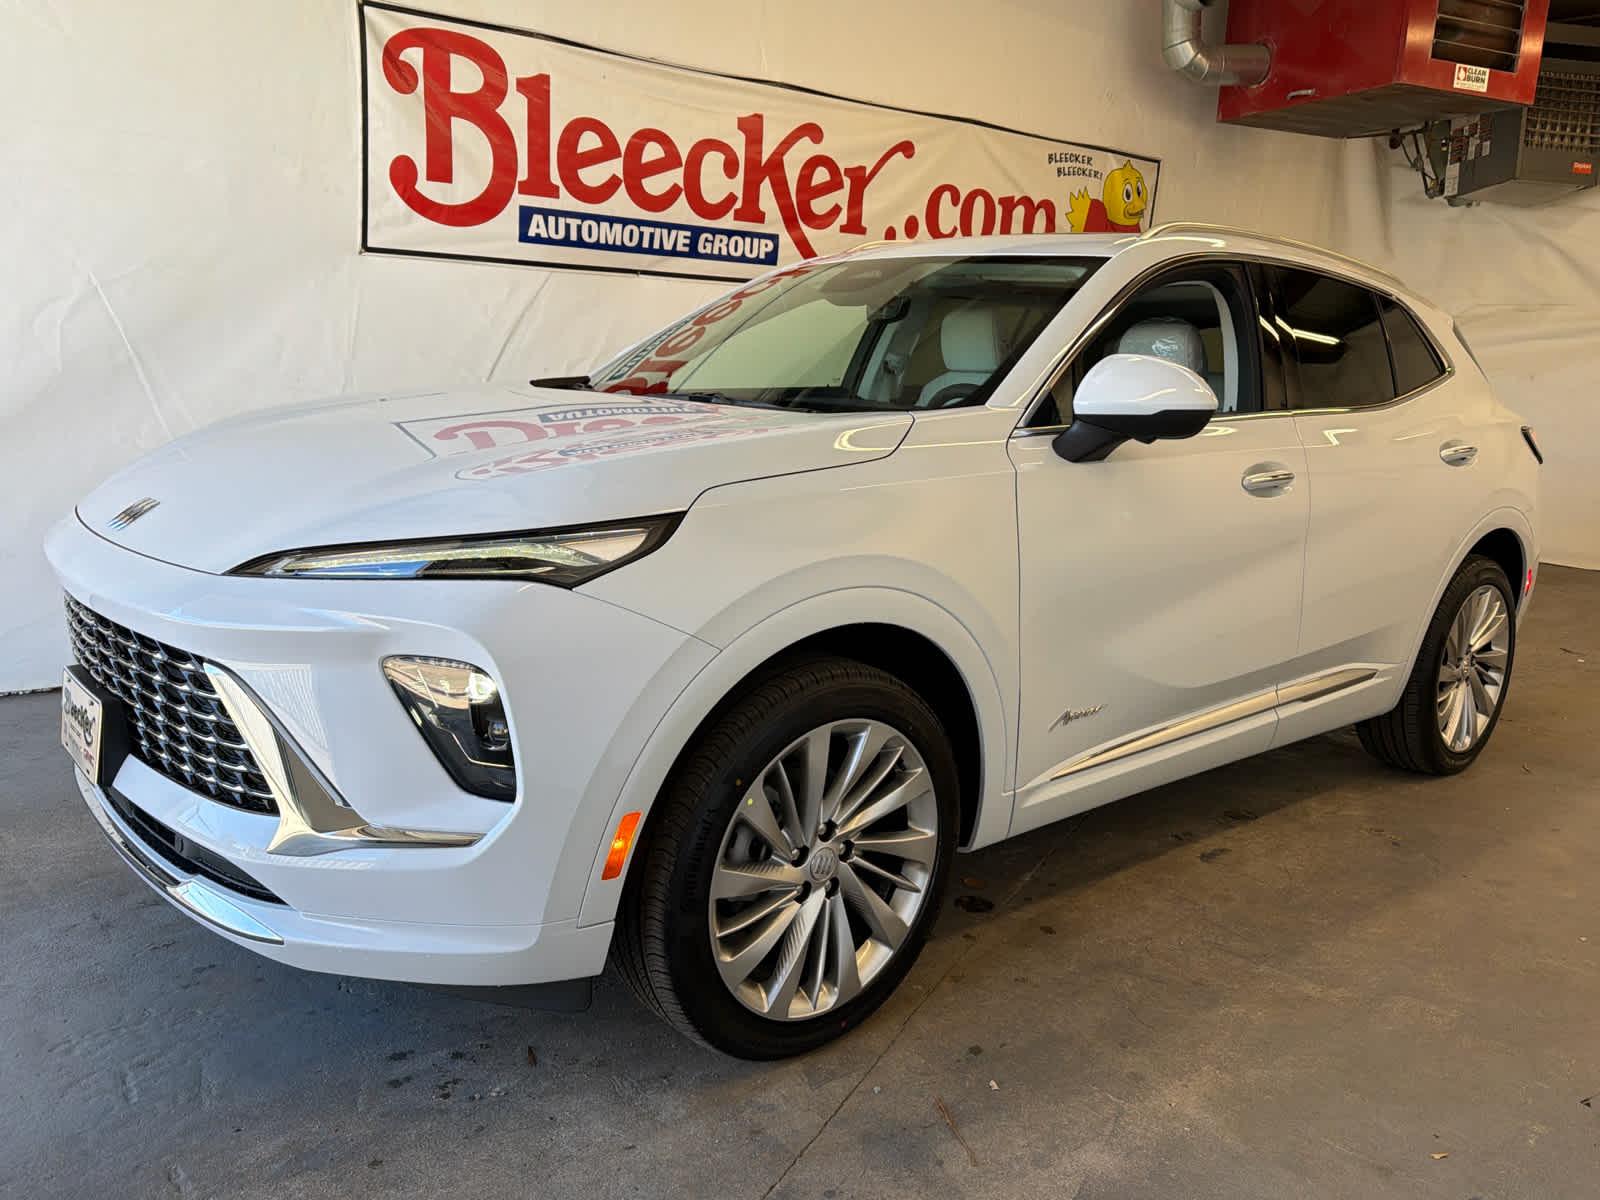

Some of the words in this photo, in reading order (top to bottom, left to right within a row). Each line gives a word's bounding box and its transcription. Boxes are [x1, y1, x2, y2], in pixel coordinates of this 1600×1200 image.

[1468, 67, 1487, 76] CLEAN
[1467, 75, 1486, 84] BURN
[1048, 152, 1093, 166] BLEECKER
[528, 213, 691, 252] AUTOMOTIVE
[697, 232, 774, 260] GROUP
